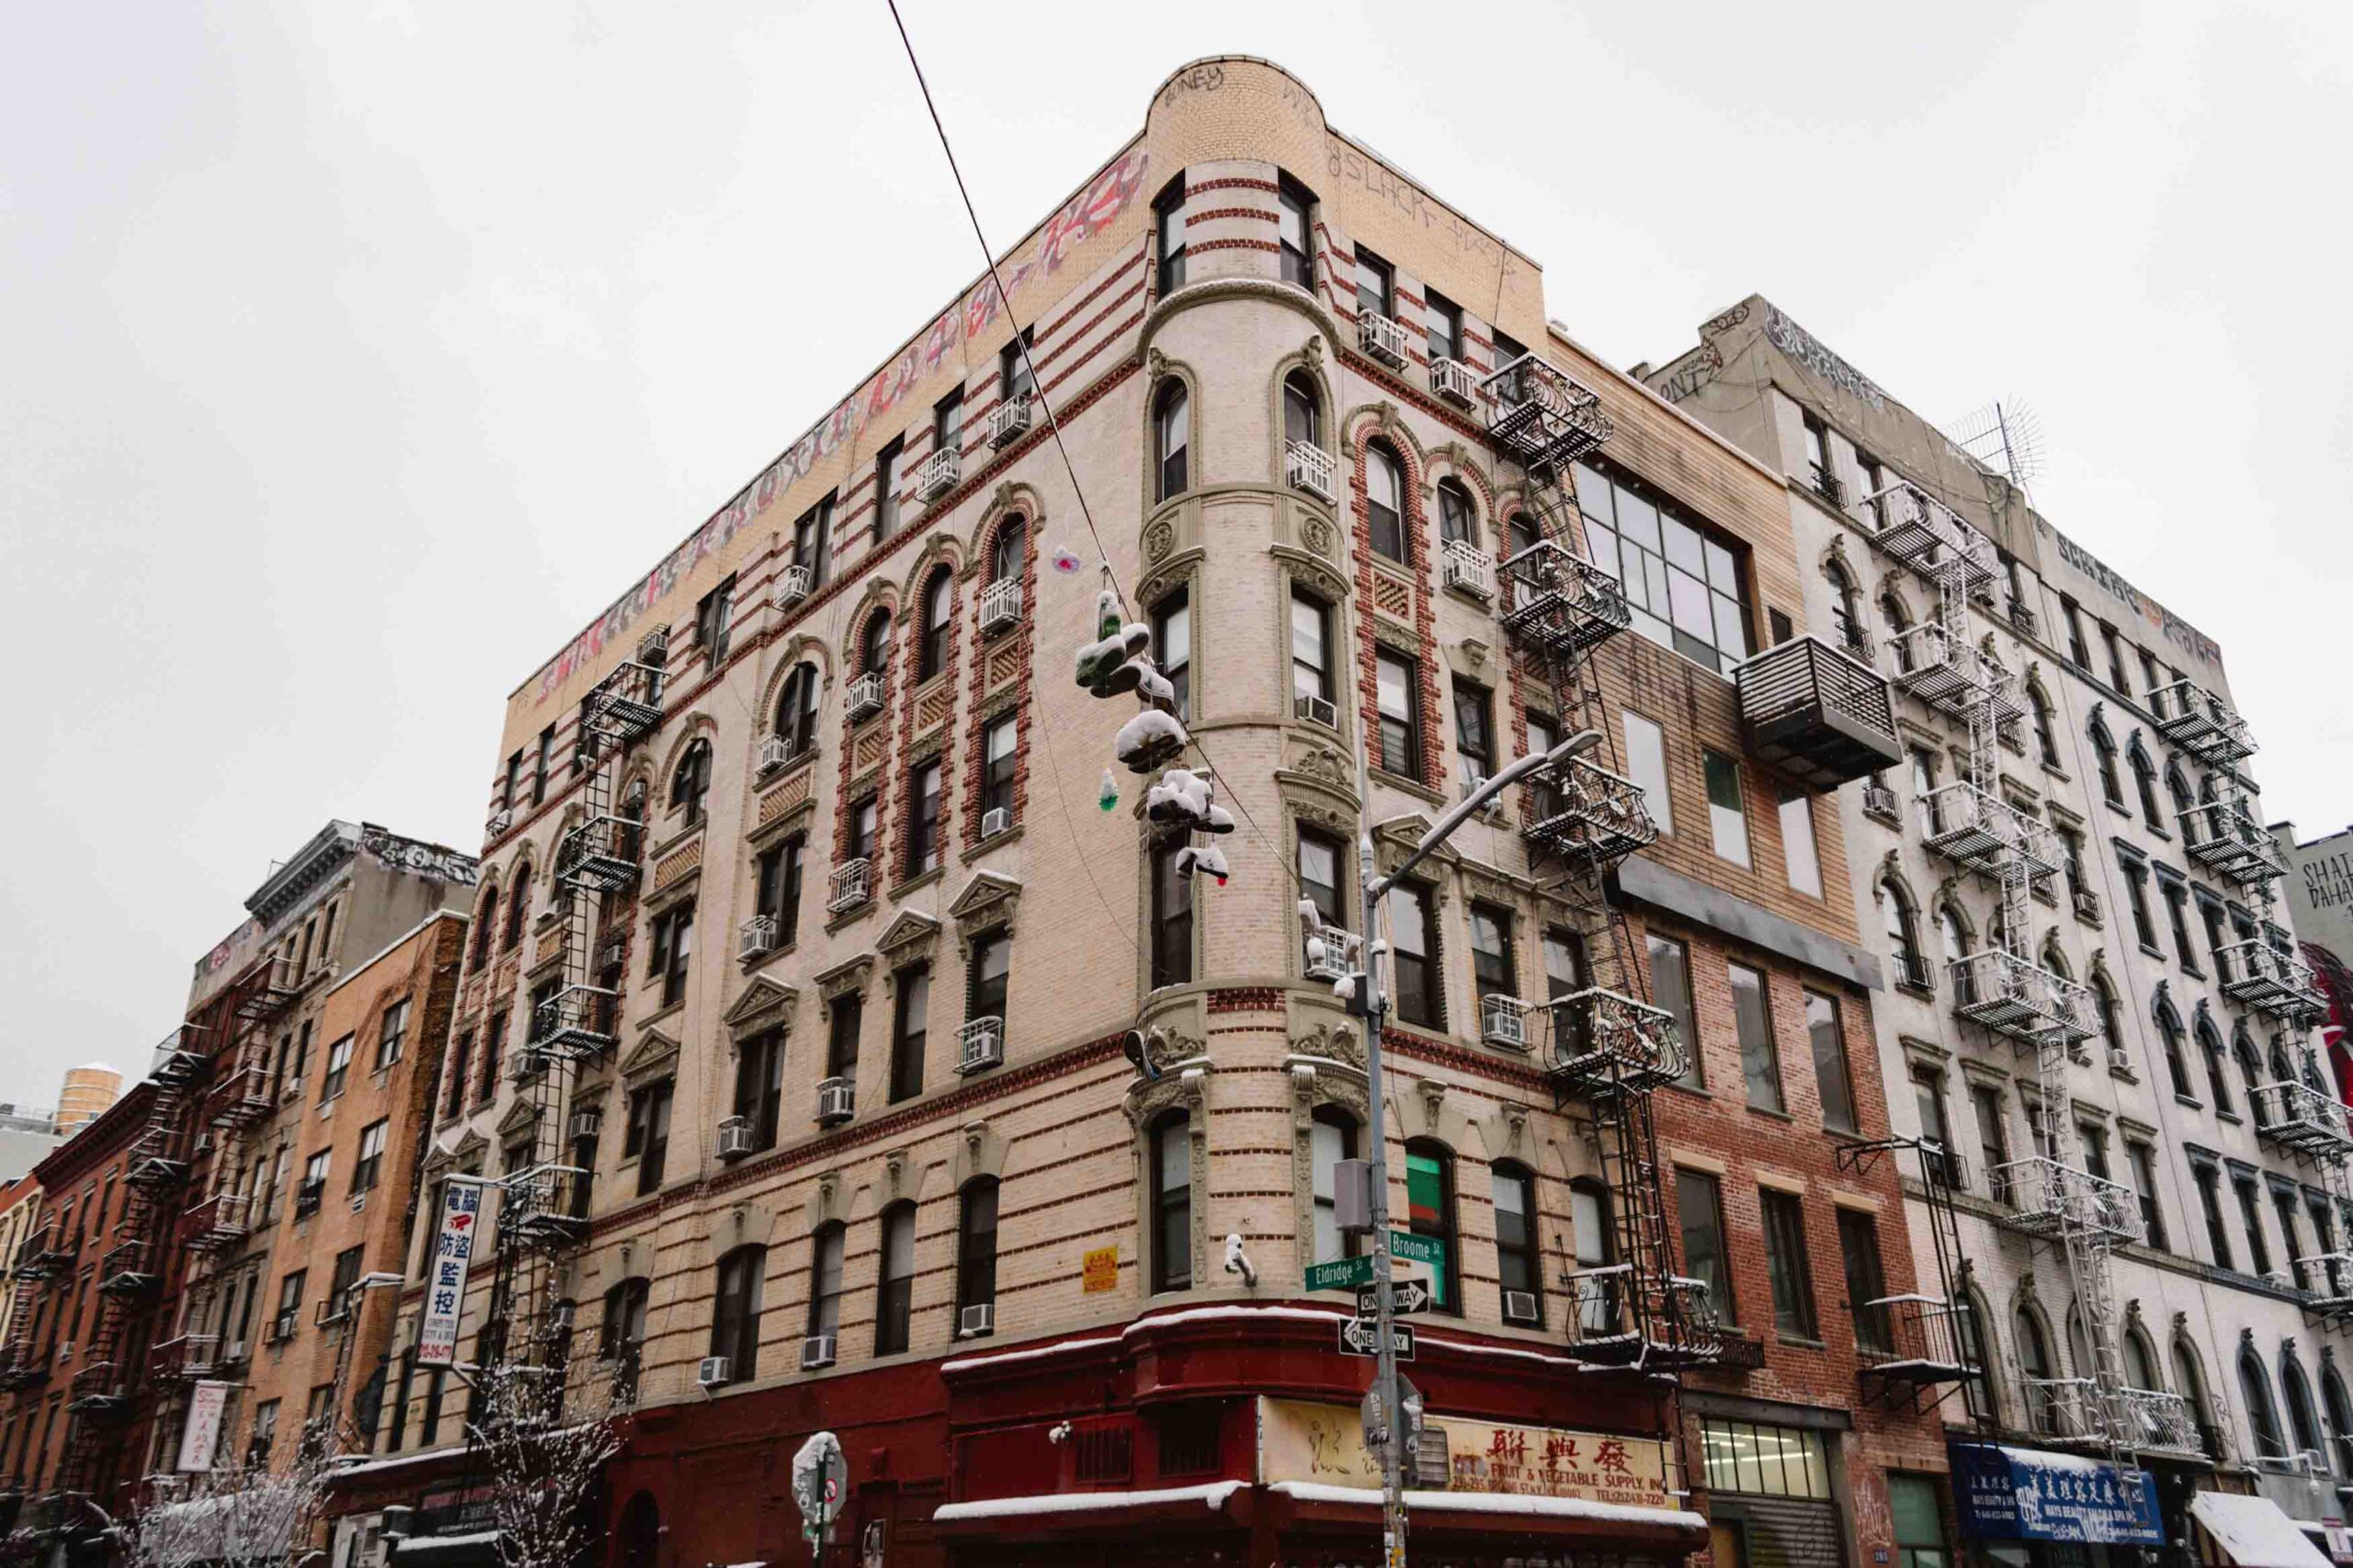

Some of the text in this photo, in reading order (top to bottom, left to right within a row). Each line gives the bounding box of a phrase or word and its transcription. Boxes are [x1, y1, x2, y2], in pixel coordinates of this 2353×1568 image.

[1392, 1234, 1440, 1259] Broome St
[1316, 1260, 1363, 1284] Eldridge St
[1396, 1290, 1418, 1304] WAY
[1351, 1330, 1372, 1344] ONE
[1491, 1463, 1520, 1479] FRUIT
[1527, 1469, 1535, 1481] &
[1539, 1469, 1598, 1486] VEGETABLE
